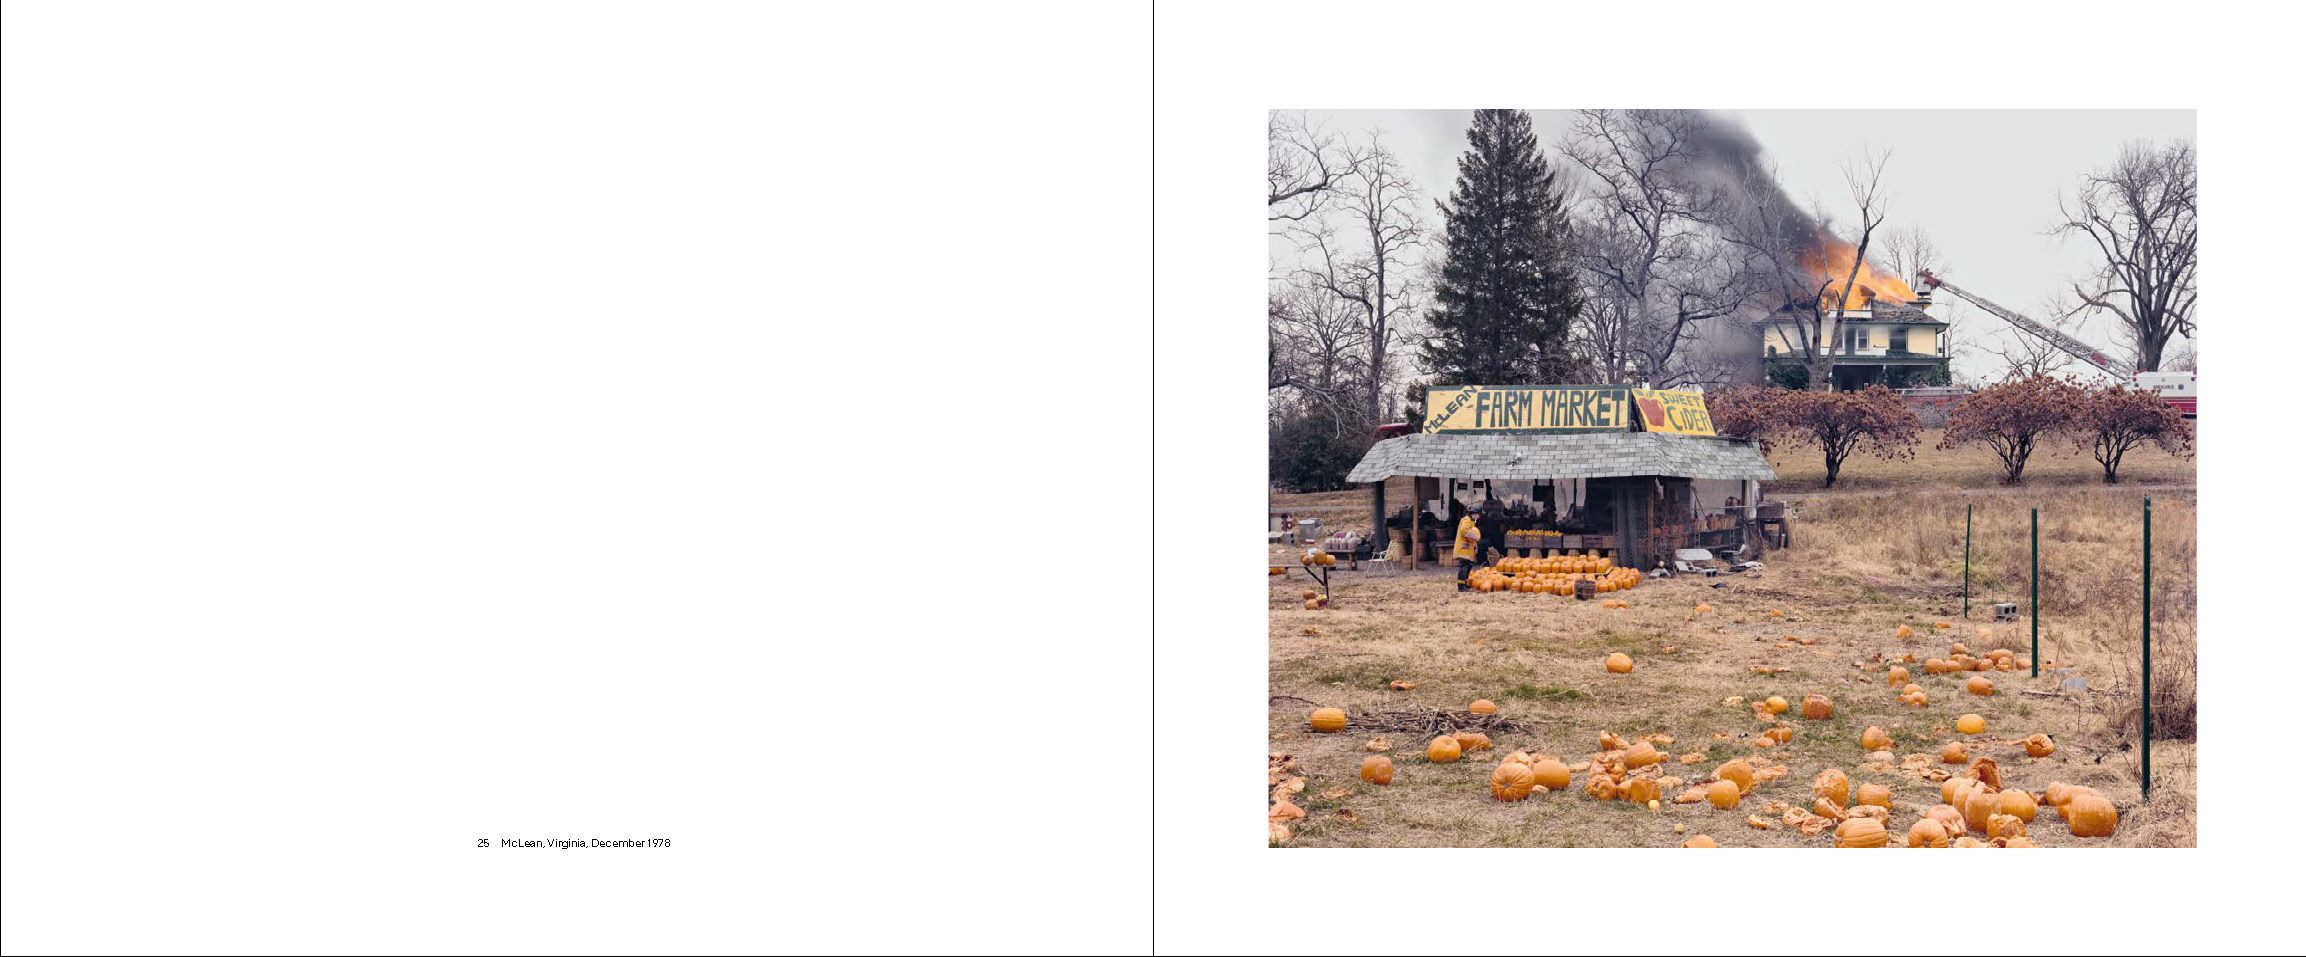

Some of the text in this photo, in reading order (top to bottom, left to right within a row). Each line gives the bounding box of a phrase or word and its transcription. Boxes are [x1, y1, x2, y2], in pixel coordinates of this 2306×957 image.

[1475, 389, 1626, 427] FARM MARKET
[1658, 391, 1701, 408] SWEET
